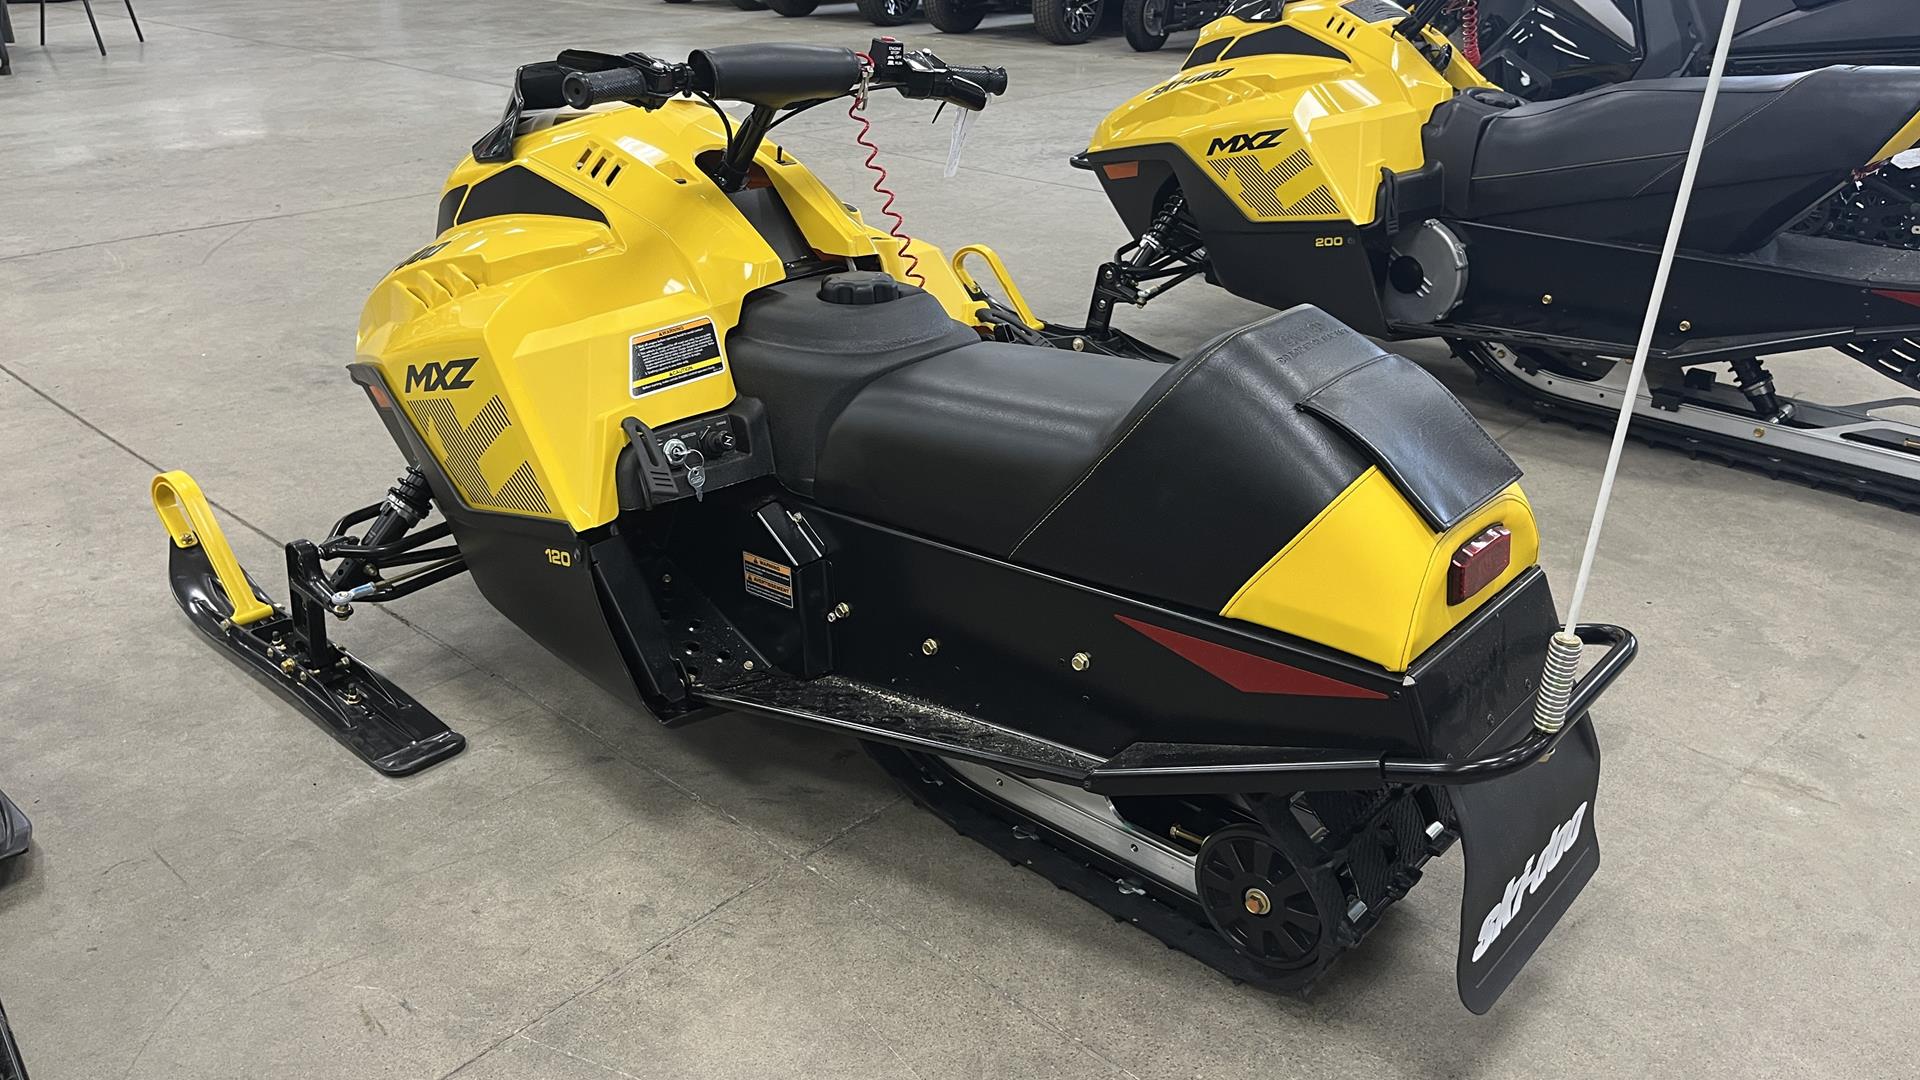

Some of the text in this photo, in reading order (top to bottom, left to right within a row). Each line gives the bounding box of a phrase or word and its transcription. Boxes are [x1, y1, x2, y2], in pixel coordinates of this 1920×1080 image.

[1206, 127, 1290, 157] MXZ
[1315, 236, 1343, 247] 200
[662, 325, 684, 336] WARNING
[404, 356, 480, 394] MXZ
[672, 366, 693, 376] CAUTION
[544, 548, 571, 567] 120
